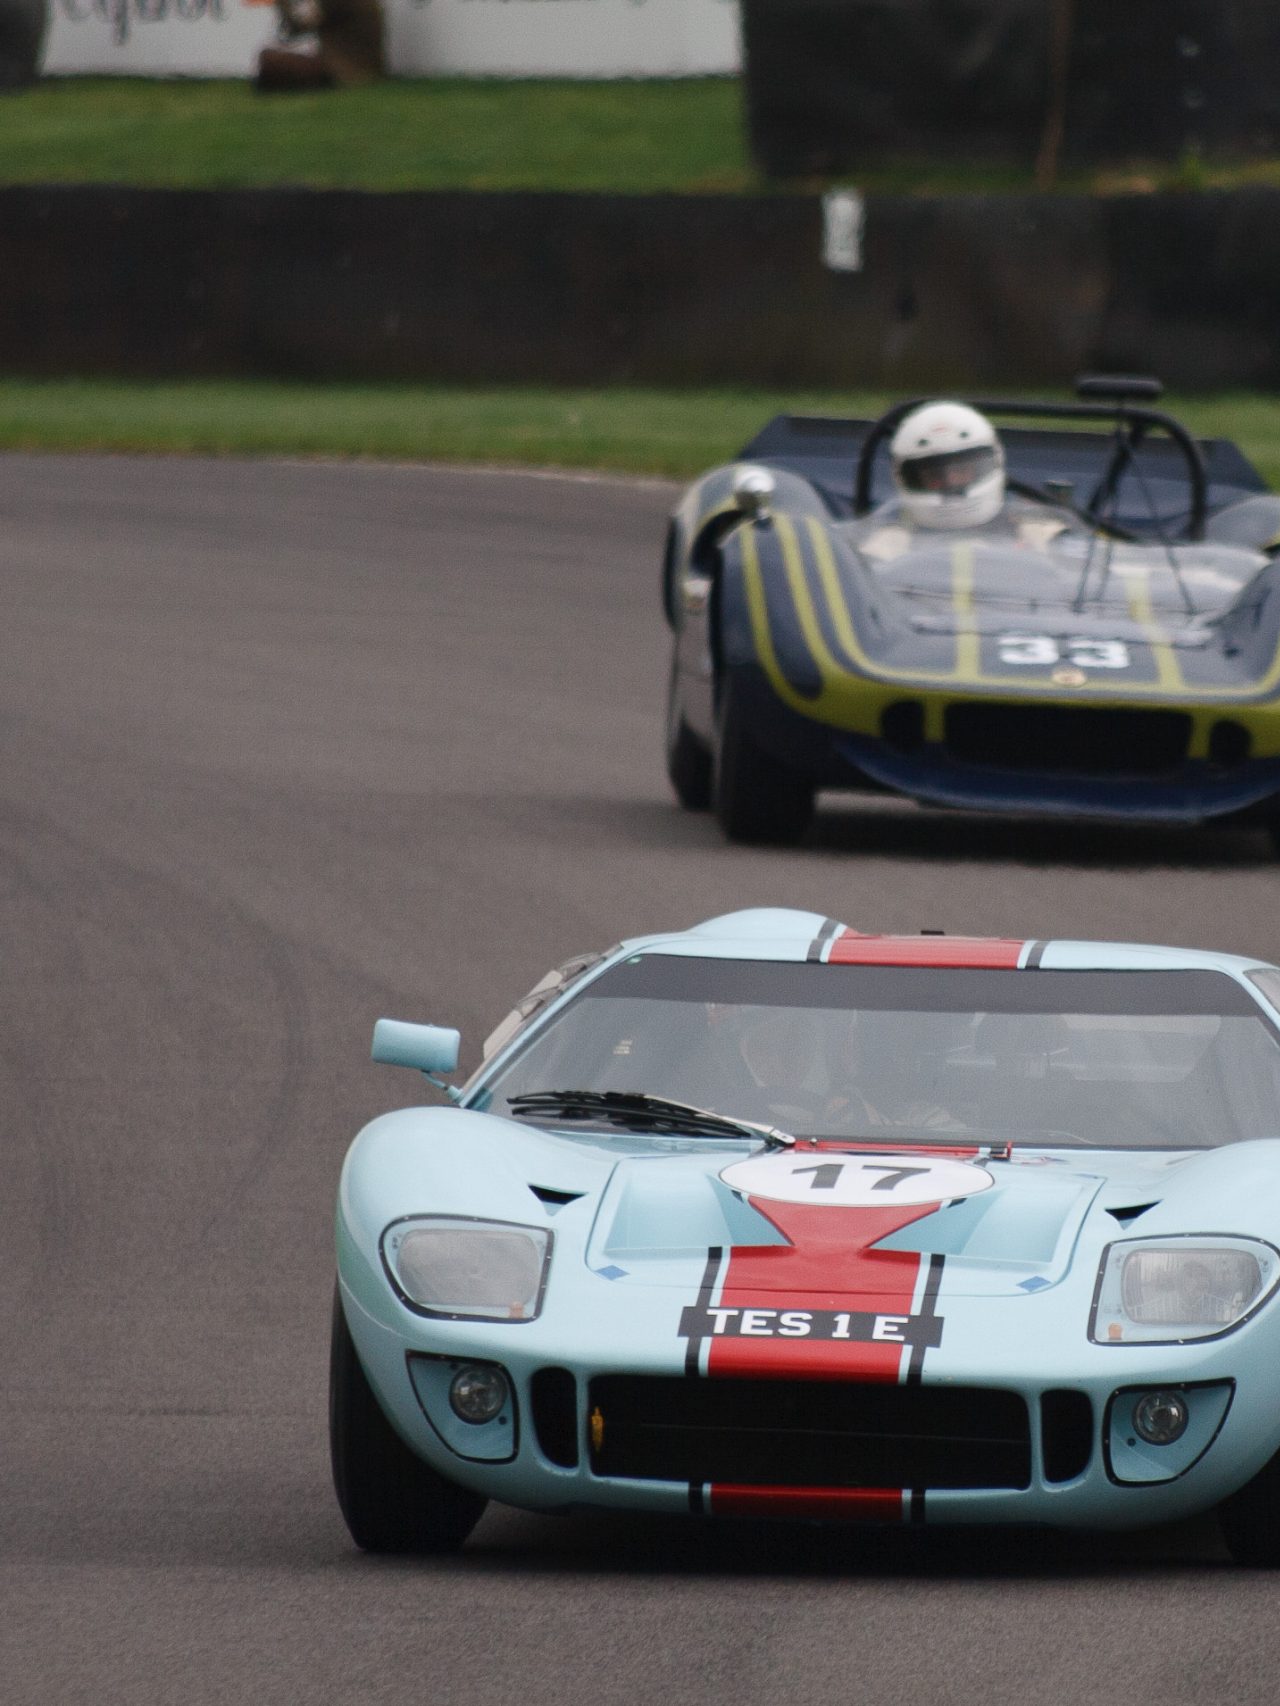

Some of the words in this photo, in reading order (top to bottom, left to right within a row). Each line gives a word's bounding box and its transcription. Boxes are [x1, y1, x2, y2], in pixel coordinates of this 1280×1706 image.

[998, 635, 1130, 669] 33
[791, 1163, 932, 1191] 17
[706, 1308, 813, 1337] TES
